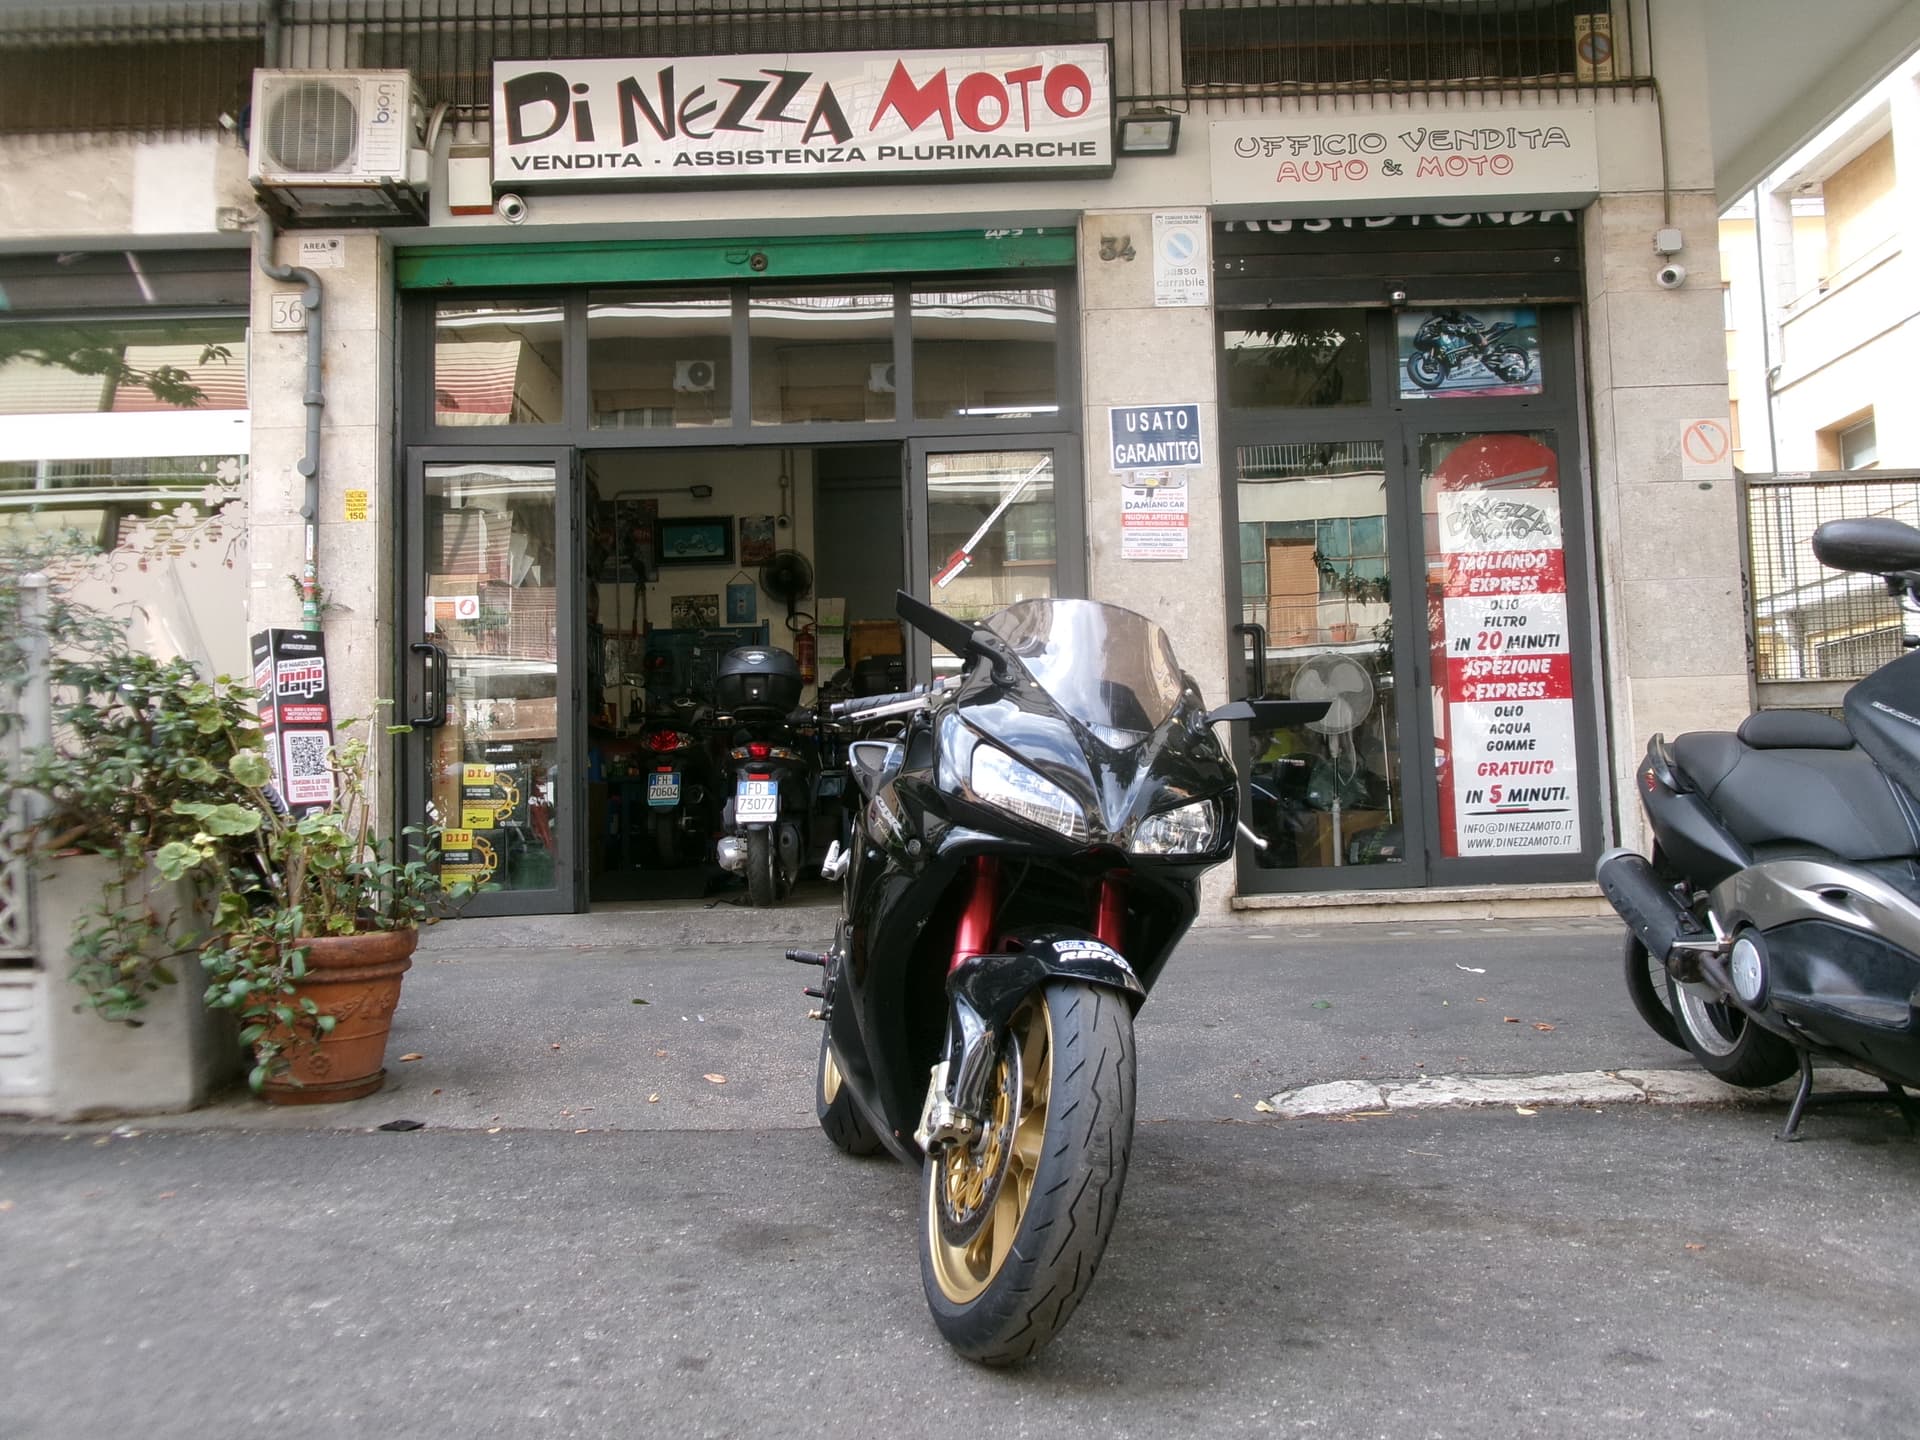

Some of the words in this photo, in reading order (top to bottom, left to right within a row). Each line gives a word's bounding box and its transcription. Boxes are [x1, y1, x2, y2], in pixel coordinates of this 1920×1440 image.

[869, 58, 1092, 140] MOTO
[1234, 133, 1388, 158] UFFICIO
[1398, 127, 1571, 152] VENDITA
[511, 152, 642, 170] VENDITA
[673, 147, 866, 167] ASSISTENZA
[878, 142, 1097, 161] PLURIMARCHE
[1277, 159, 1369, 182] AUTO
[1381, 159, 1403, 176] &
[1417, 154, 1514, 177] MOTO
[1099, 235, 1136, 262] 34
[1164, 267, 1197, 279] passo
[1156, 278, 1205, 288] carrabile
[274, 300, 303, 323] 36
[1126, 410, 1188, 432] USATO
[1115, 440, 1199, 464] GARANTITO
[1125, 500, 1169, 510] DAMIANO
[1457, 553, 1548, 570] TAGLIANDO
[1470, 575, 1540, 593] EXPRESS
[1490, 599, 1520, 611] OLIO
[1484, 616, 1527, 627] FILTRO
[1454, 638, 1471, 651] IN
[1477, 631, 1503, 651] 20
[1507, 634, 1560, 649] MINUTI
[1466, 658, 1552, 676] ISPEZIONE
[279, 680, 323, 696] days
[1476, 681, 1546, 699] EXPRESS
[1494, 705, 1524, 717] OLIO
[1489, 722, 1531, 735] ACQUA
[1486, 739, 1536, 752] GOMME
[1478, 760, 1554, 777] GRATUITO
[651, 787, 678, 797] 70604
[748, 783, 761, 794] FD
[1466, 789, 1484, 804] IN
[1489, 784, 1503, 804] 5
[740, 798, 775, 810] 73077
[1463, 819, 1574, 835] INFO@DINEZZAMOTO.IT
[446, 833, 469, 842] DID
[1467, 835, 1573, 849] WWW.DINEZZAMOTO.IT
